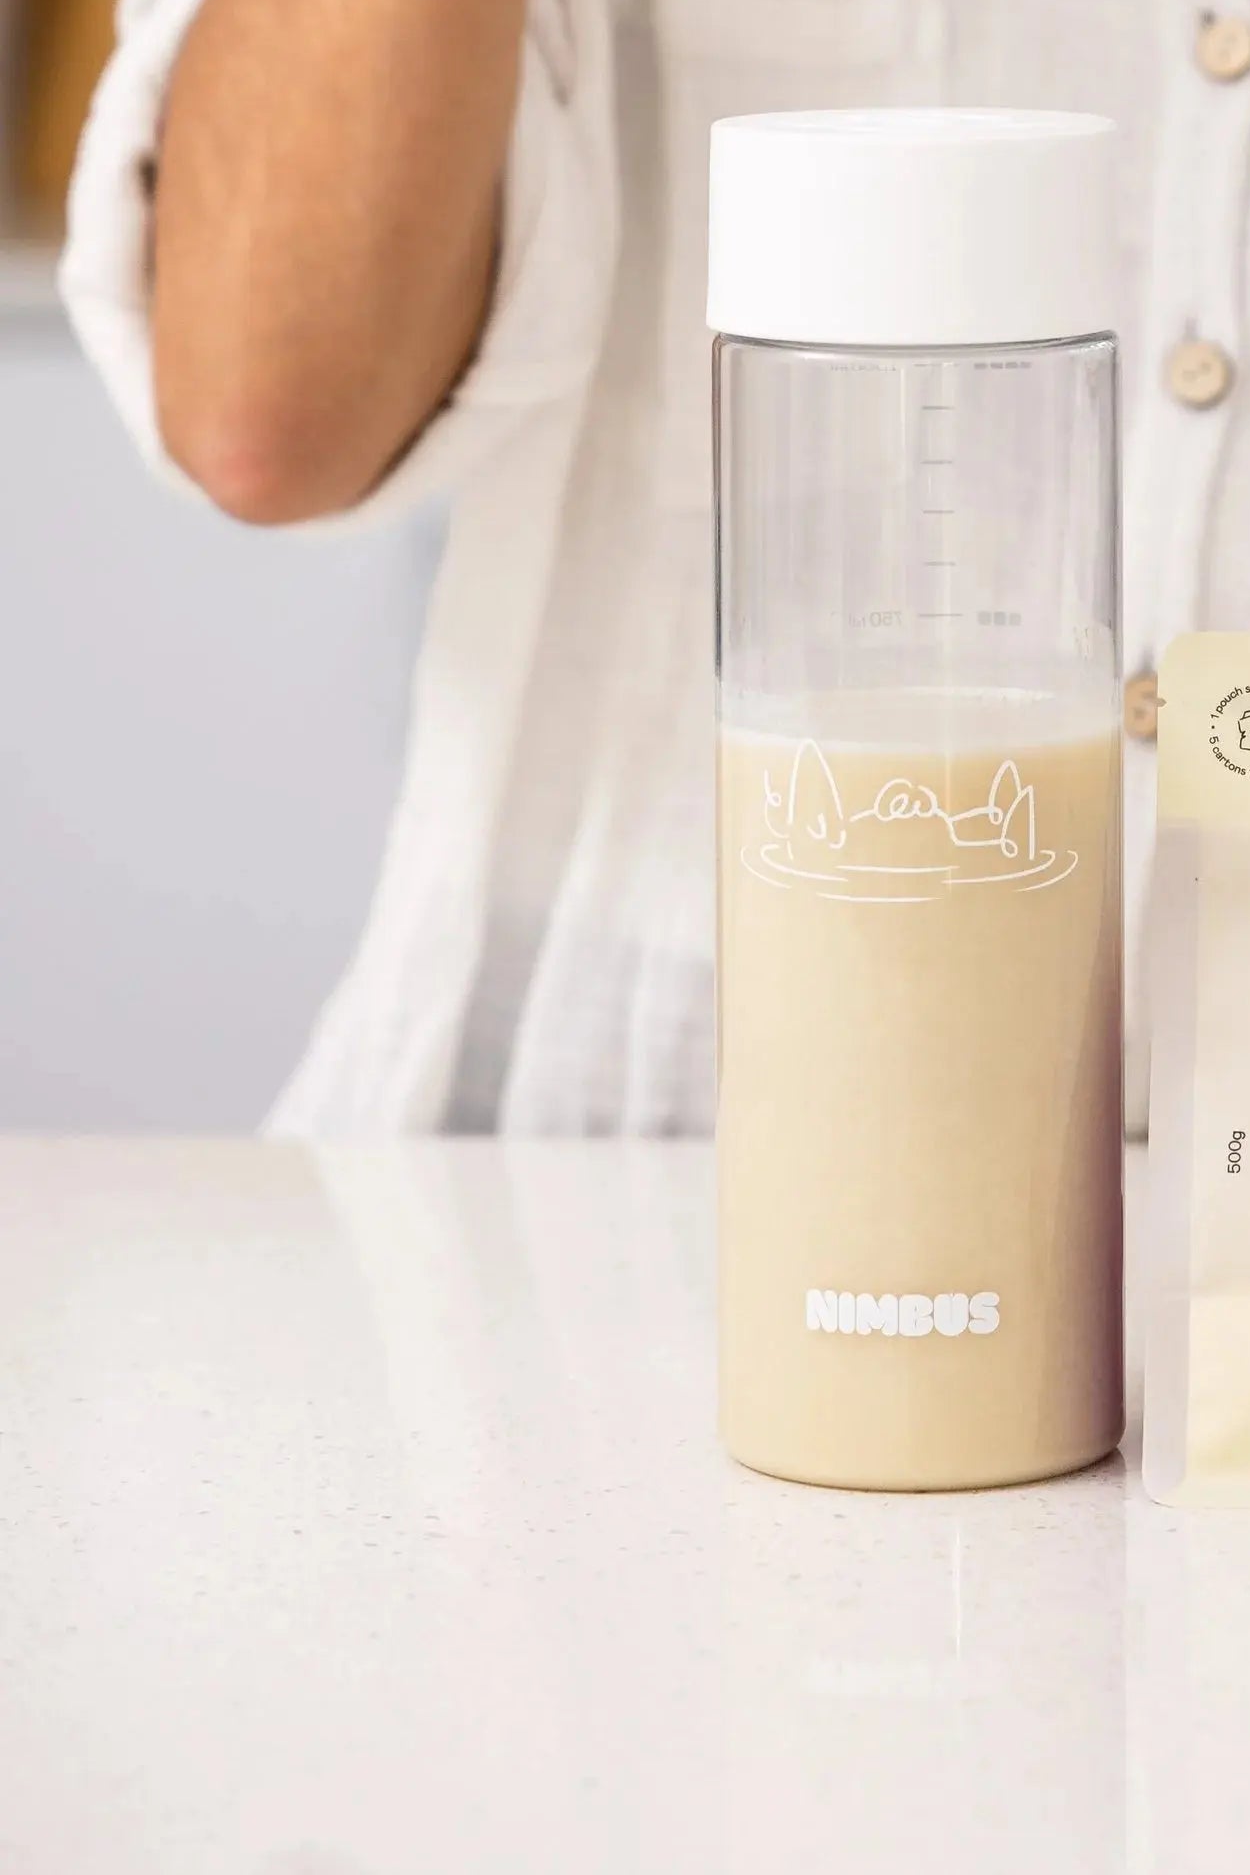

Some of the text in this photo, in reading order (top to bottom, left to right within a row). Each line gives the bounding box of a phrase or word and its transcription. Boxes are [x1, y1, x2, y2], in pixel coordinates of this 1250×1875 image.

[1216, 687, 1243, 715] pouch
[1209, 735, 1219, 745] 5
[1212, 746, 1246, 776] cartons
[1227, 1130, 1246, 1174] 500g
[805, 1288, 1001, 1337] NIMBUS
